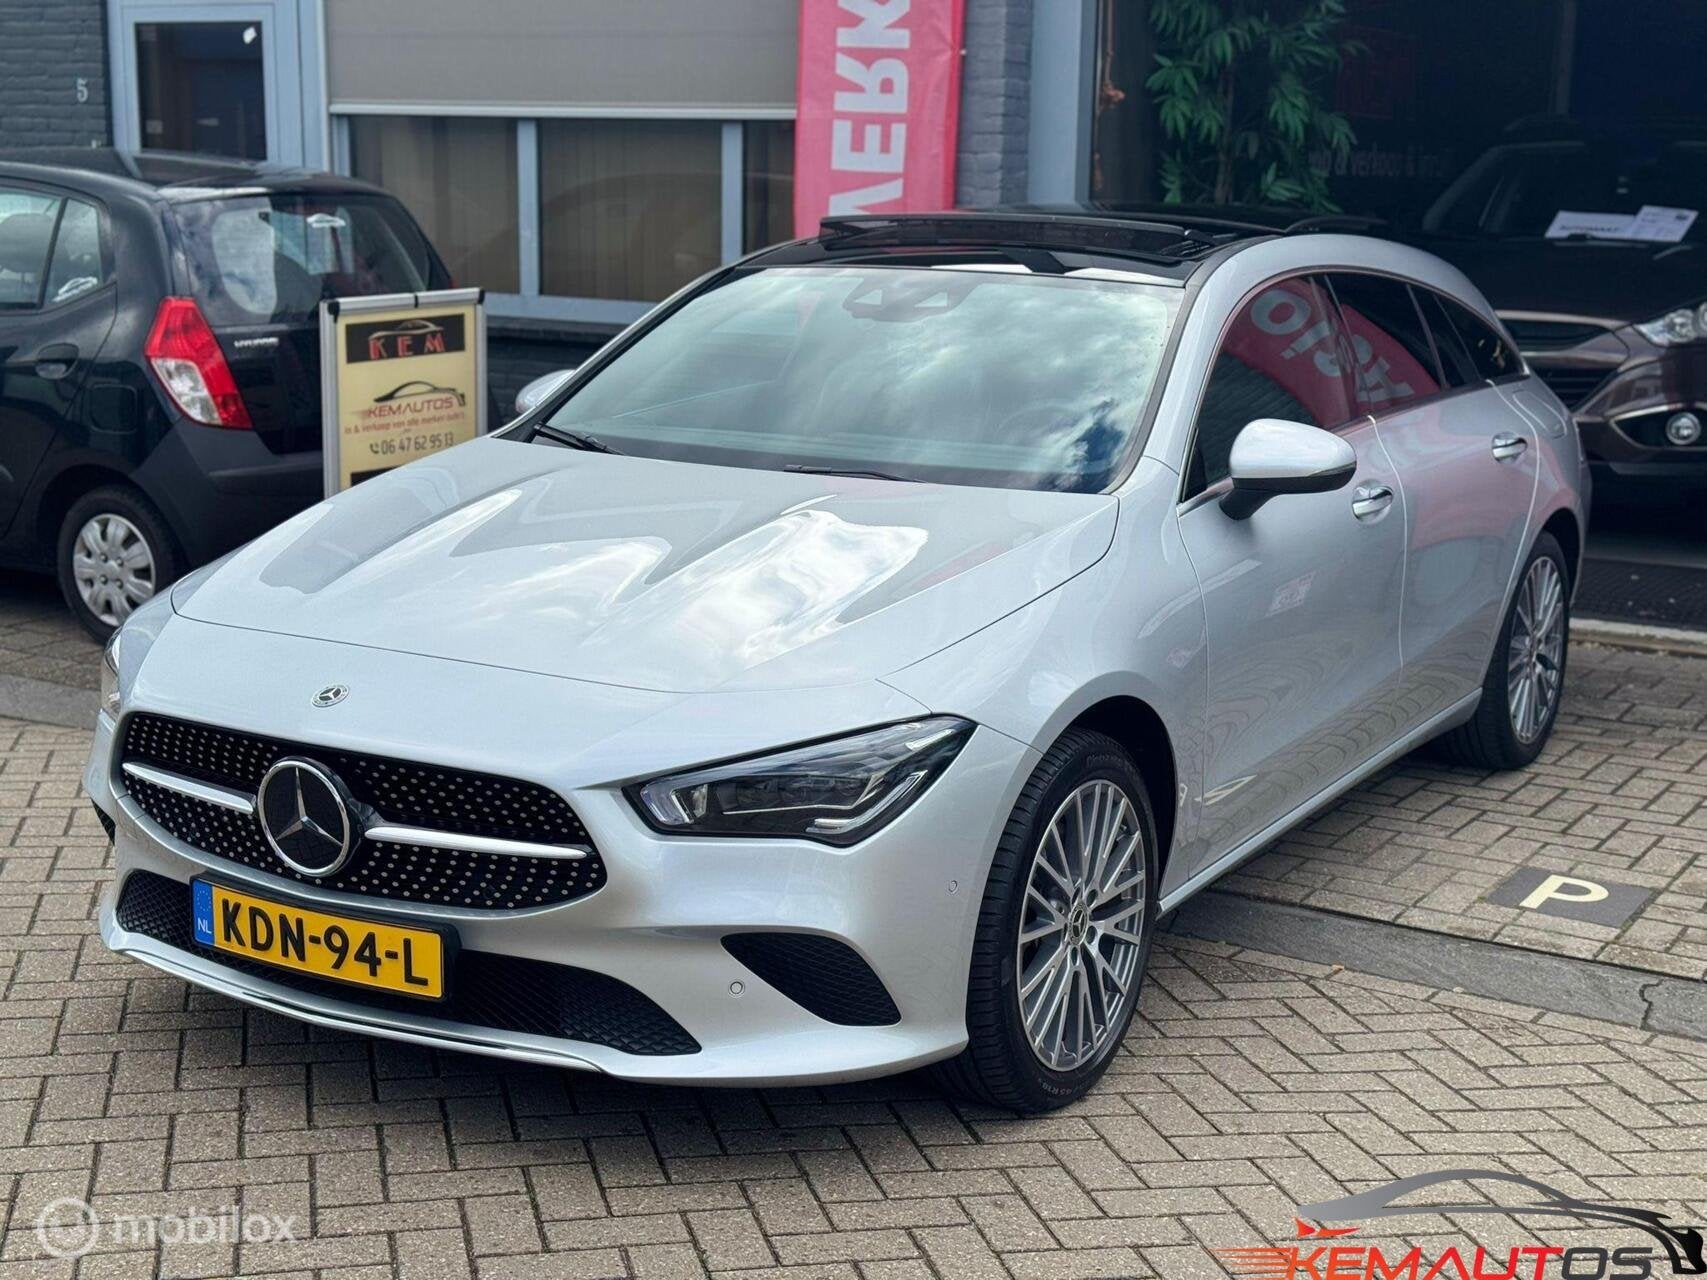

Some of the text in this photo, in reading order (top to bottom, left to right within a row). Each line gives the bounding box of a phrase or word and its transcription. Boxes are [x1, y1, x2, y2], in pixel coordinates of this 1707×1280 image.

[76, 78, 89, 102] 5
[368, 333, 445, 361] KEM
[367, 397, 453, 417] KEMAUTOS
[381, 439, 396, 455] 06
[398, 436, 412, 452] 47
[414, 435, 427, 451] 62
[429, 432, 442, 449] 95
[444, 430, 454, 447] 13
[1519, 874, 1610, 910] P
[197, 917, 212, 935] NL
[221, 898, 430, 987] KDN-94-L
